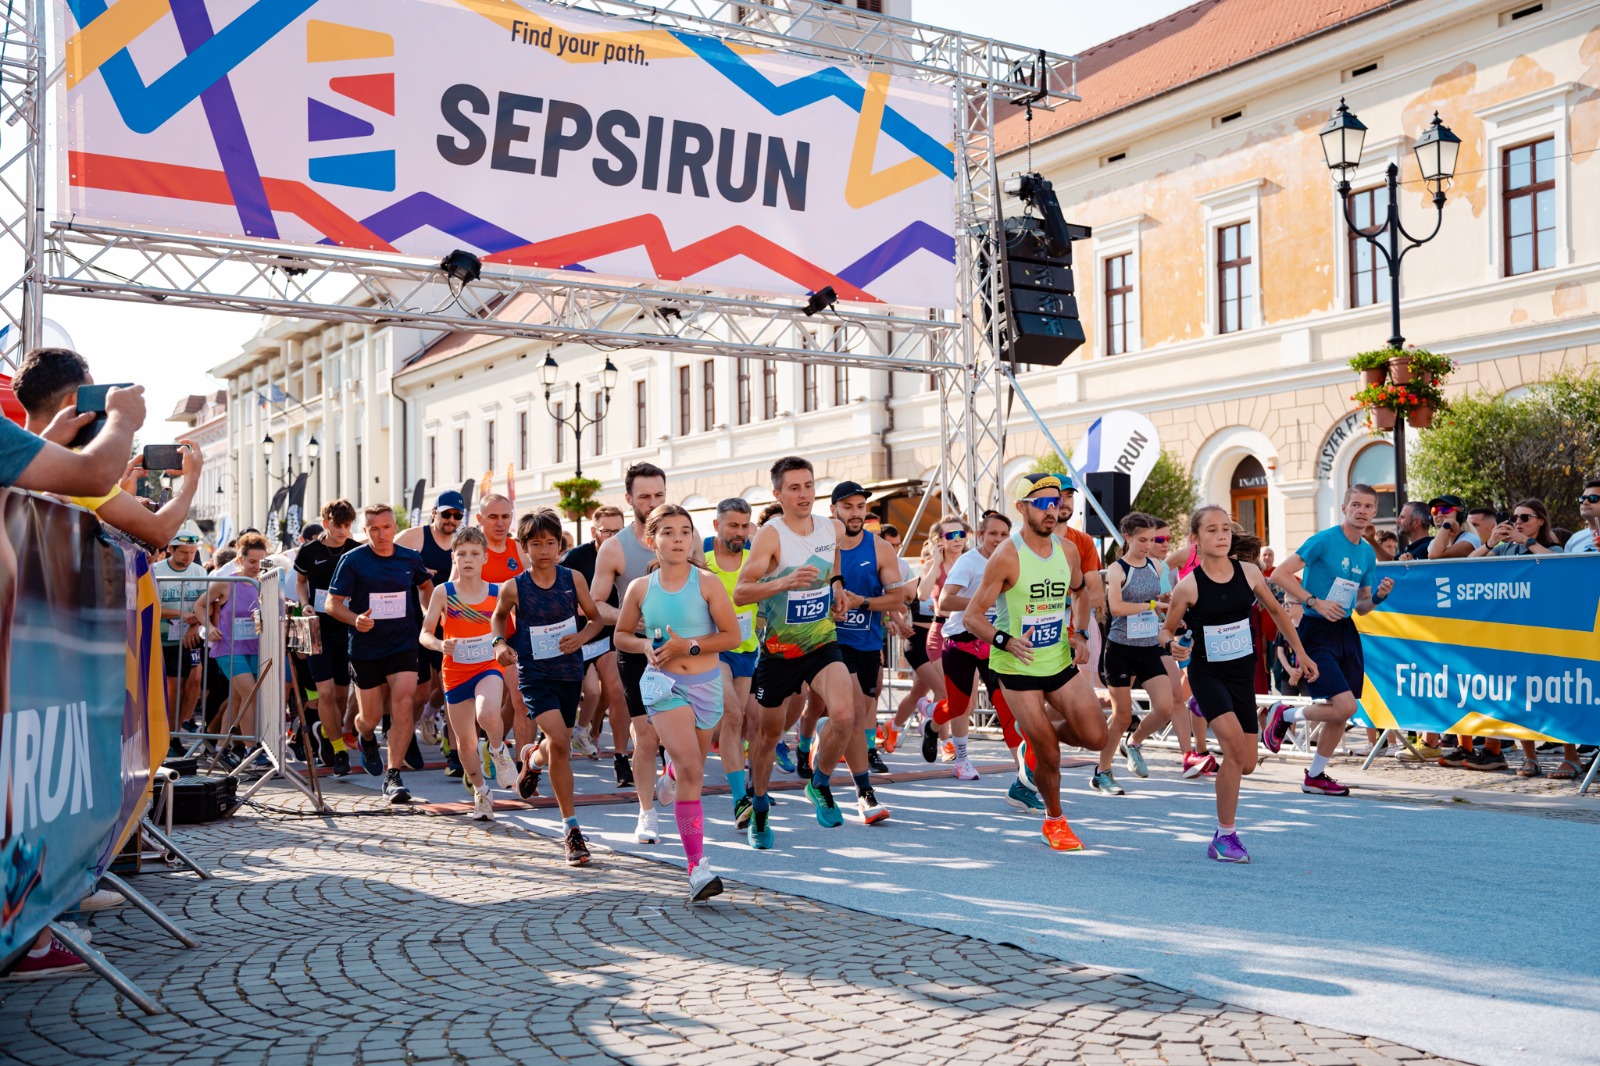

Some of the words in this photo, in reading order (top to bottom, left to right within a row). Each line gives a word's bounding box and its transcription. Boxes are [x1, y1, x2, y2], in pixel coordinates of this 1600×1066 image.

[511, 20, 552, 49] Find
[556, 32, 600, 57] your
[603, 43, 650, 67] path.
[436, 83, 811, 212] SEPSIRUN
[1456, 582, 1531, 600] SEPSIRUN
[795, 602, 825, 617] 1129
[843, 612, 865, 624] 120
[1031, 627, 1058, 642] 1135
[458, 646, 489, 658] 5168
[1210, 635, 1249, 654] 5009
[1395, 662, 1449, 699] Find
[1456, 673, 1518, 709] your
[1525, 667, 1600, 712] path.
